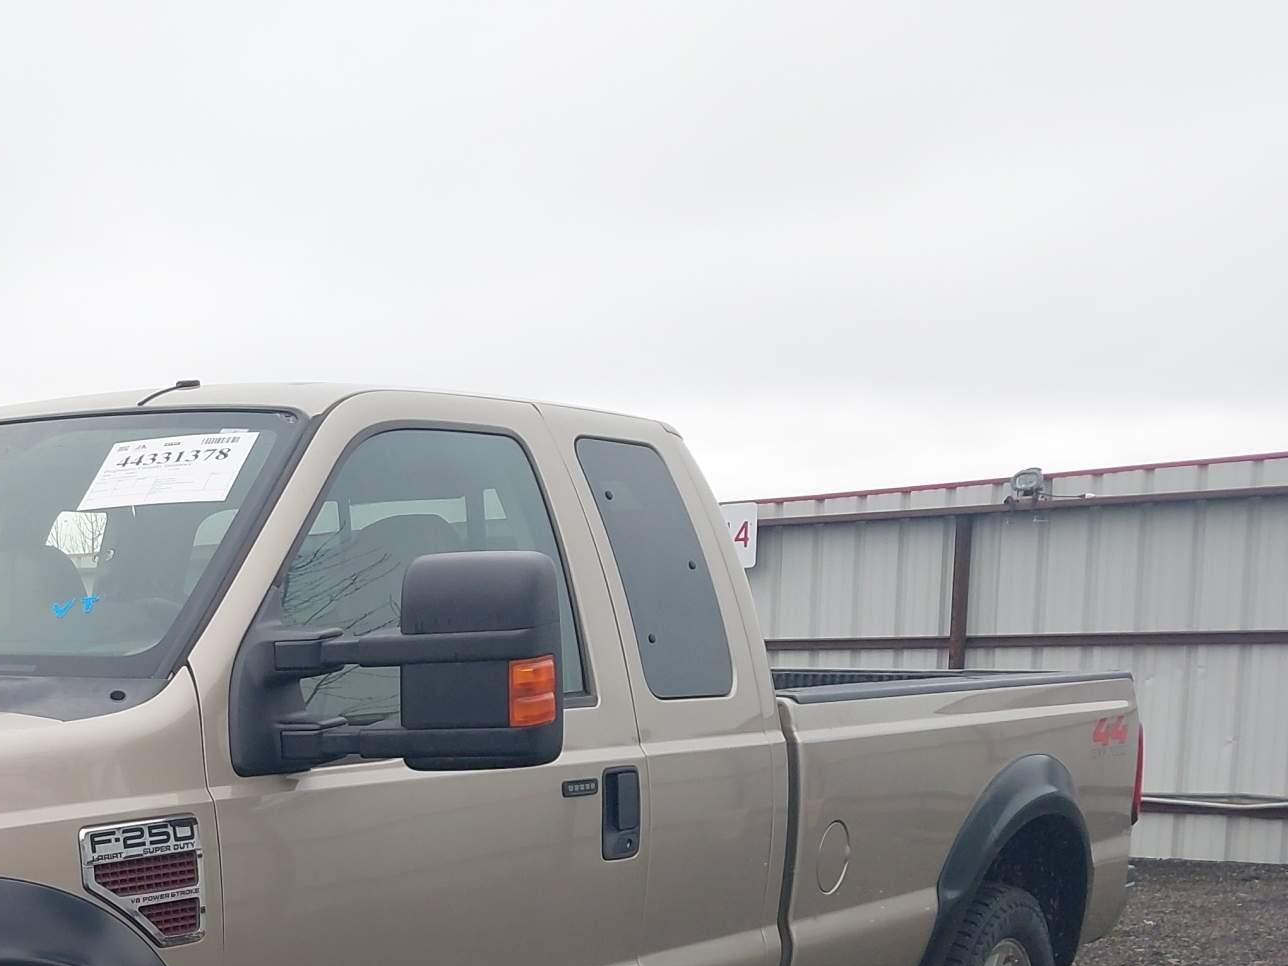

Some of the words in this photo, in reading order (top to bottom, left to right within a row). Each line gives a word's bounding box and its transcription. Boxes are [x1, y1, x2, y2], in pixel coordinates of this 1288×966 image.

[116, 448, 231, 467] 44331378
[734, 520, 750, 548] 4
[90, 821, 195, 854] F-250
[143, 845, 172, 855] SUPER
[173, 841, 196, 851] DUTY
[143, 892, 170, 902] POWER
[171, 887, 200, 898] STROKE
